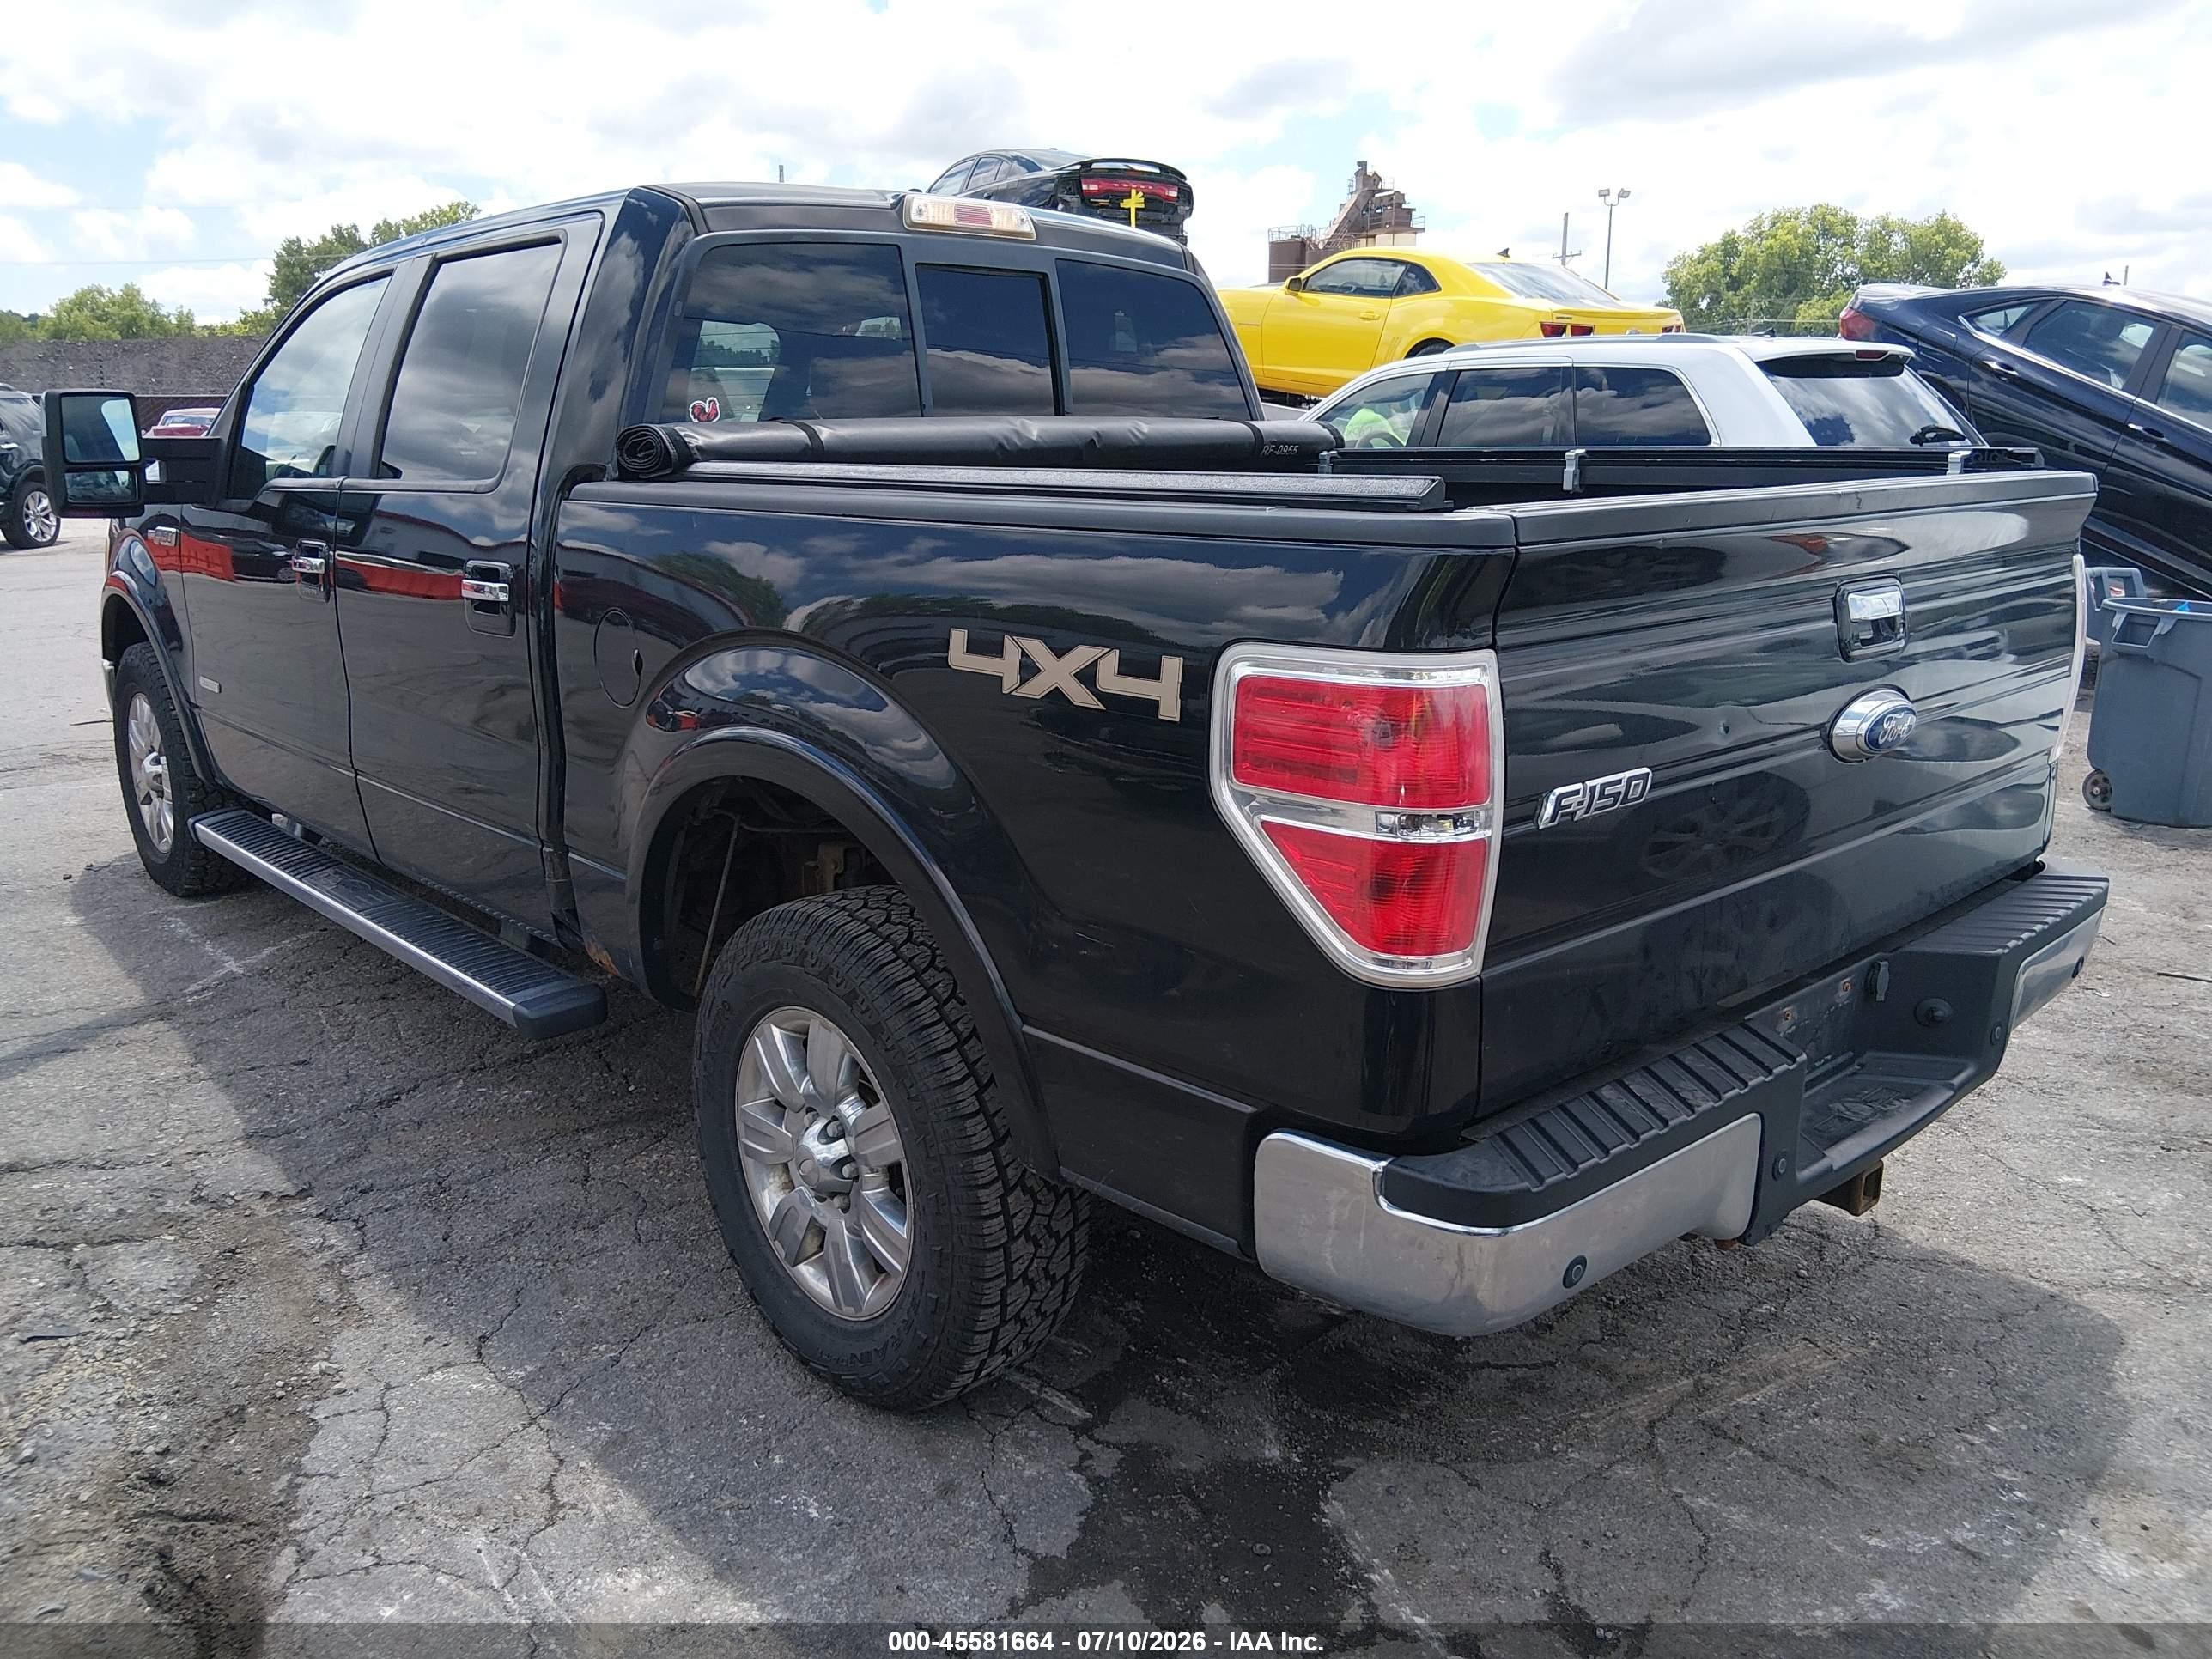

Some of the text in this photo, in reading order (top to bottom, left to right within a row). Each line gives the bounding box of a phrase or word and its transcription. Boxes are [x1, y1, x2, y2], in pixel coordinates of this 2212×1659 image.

[1261, 445, 1298, 455] RF-0955
[948, 628, 1183, 722] 4X4
[1878, 712, 1916, 744] Ford
[1539, 767, 1652, 830] F-150
